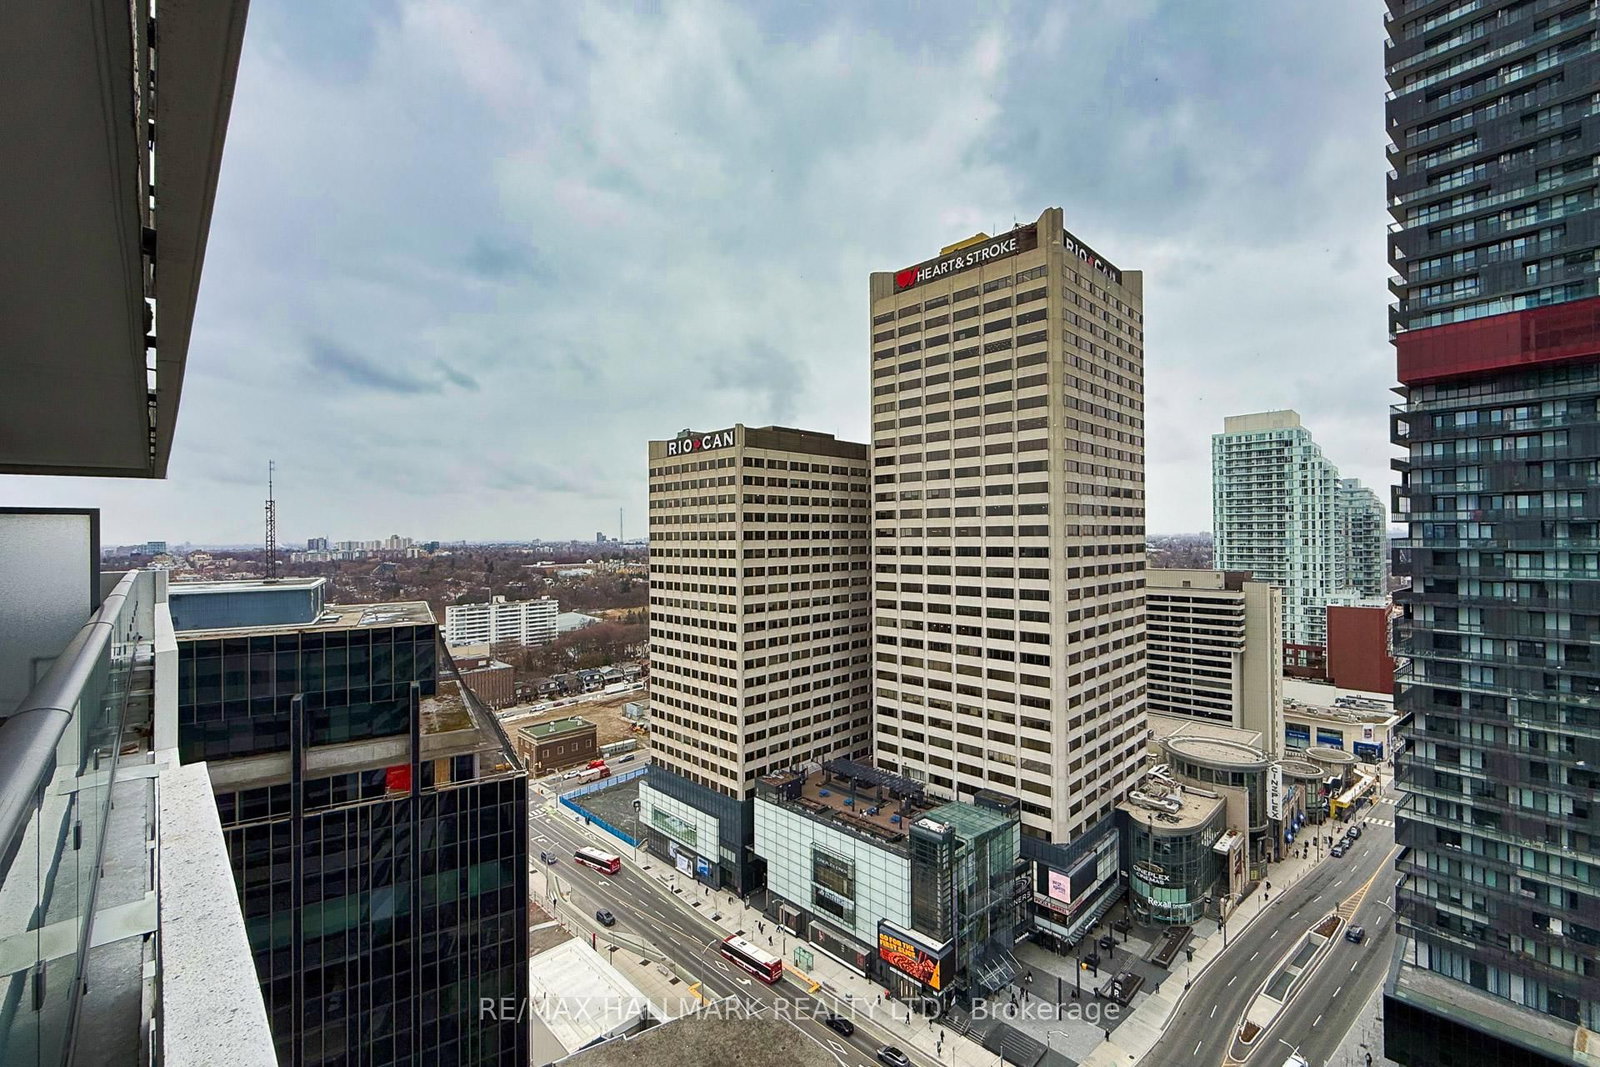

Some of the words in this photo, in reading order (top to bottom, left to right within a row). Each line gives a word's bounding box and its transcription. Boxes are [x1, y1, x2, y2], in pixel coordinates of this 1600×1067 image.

[1271, 766, 1279, 819] CINEPLEX
[1132, 864, 1170, 882] CINEPLEX
[1136, 872, 1165, 885] CINEMAS
[1147, 896, 1171, 908] Rexall
[889, 936, 902, 945] FOR
[902, 942, 915, 952] THE
